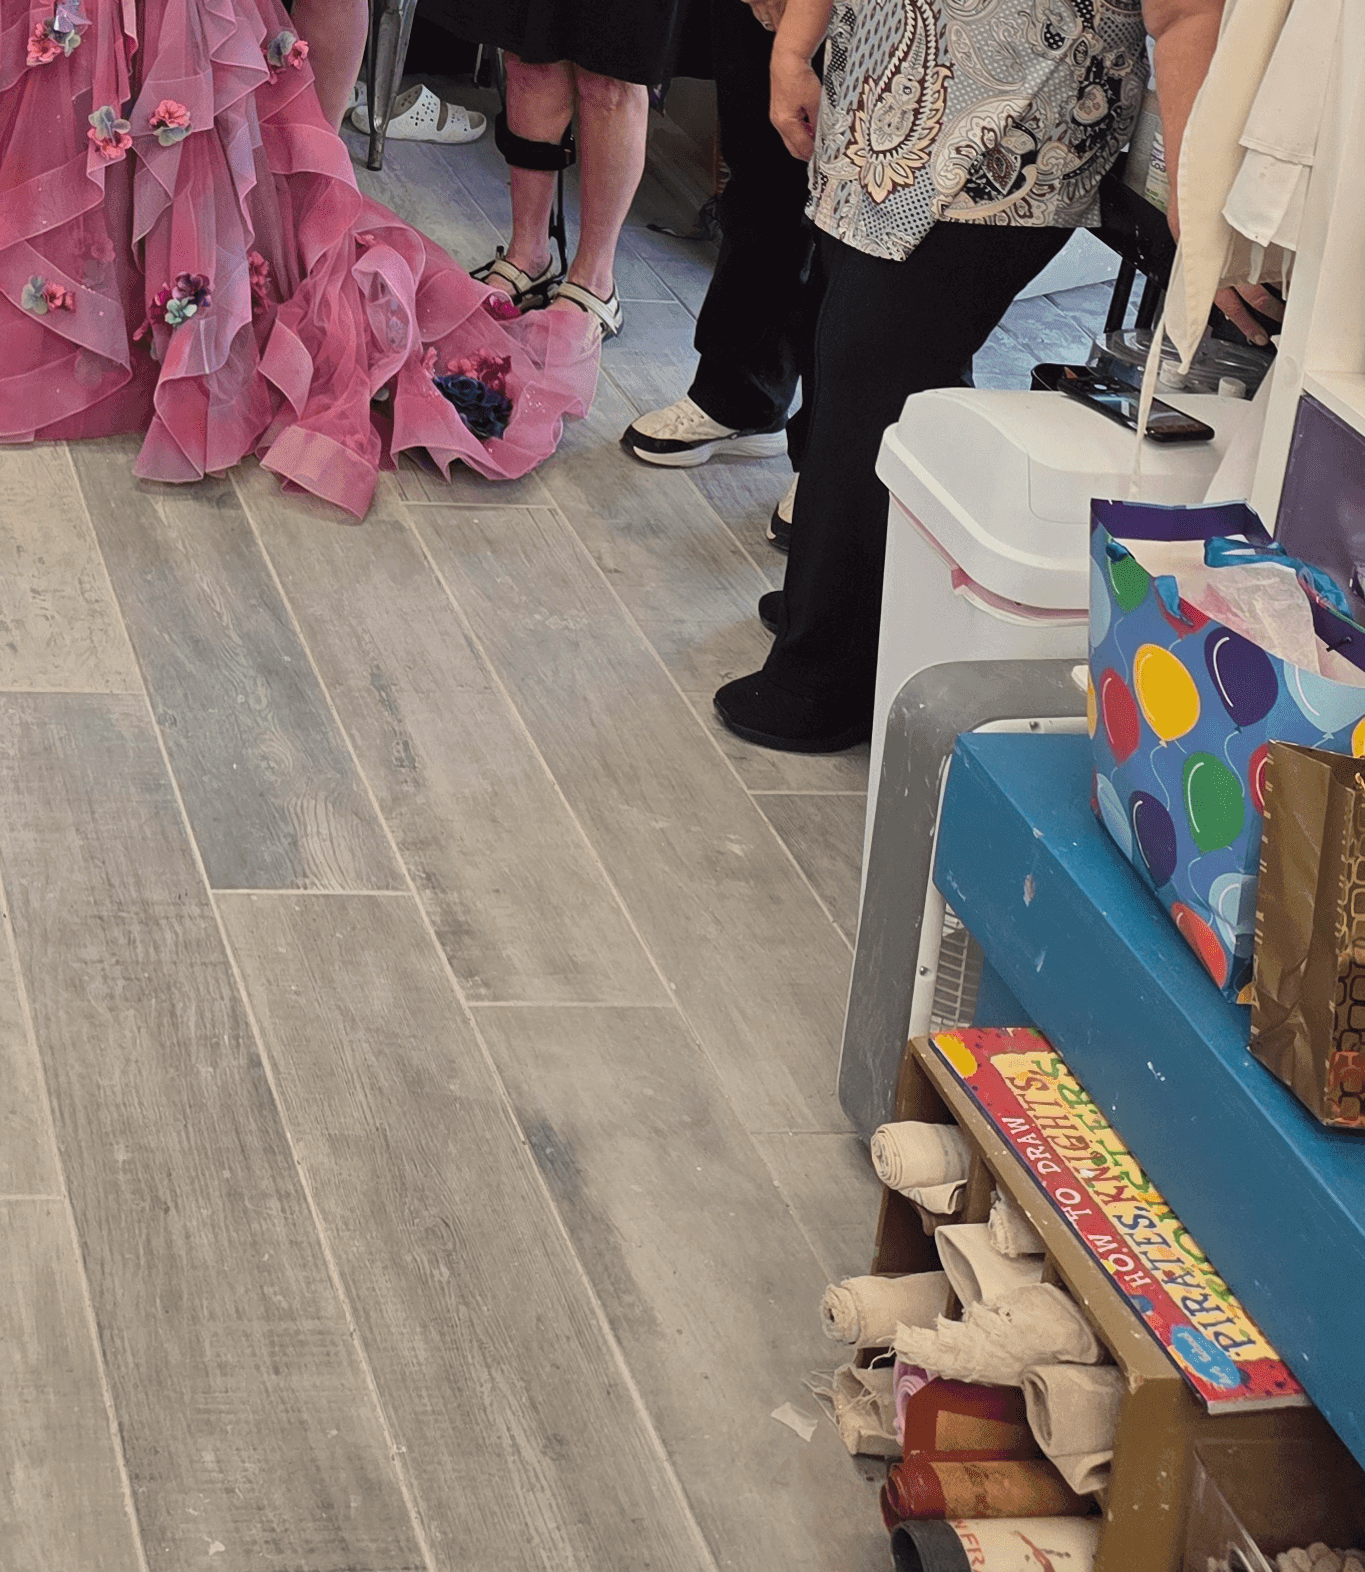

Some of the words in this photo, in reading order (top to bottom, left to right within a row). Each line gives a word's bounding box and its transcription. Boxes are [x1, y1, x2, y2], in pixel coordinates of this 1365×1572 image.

[1001, 1115, 1062, 1176] DRAW
[1055, 1187, 1092, 1229] TO
[1086, 1232, 1152, 1289] HOW
